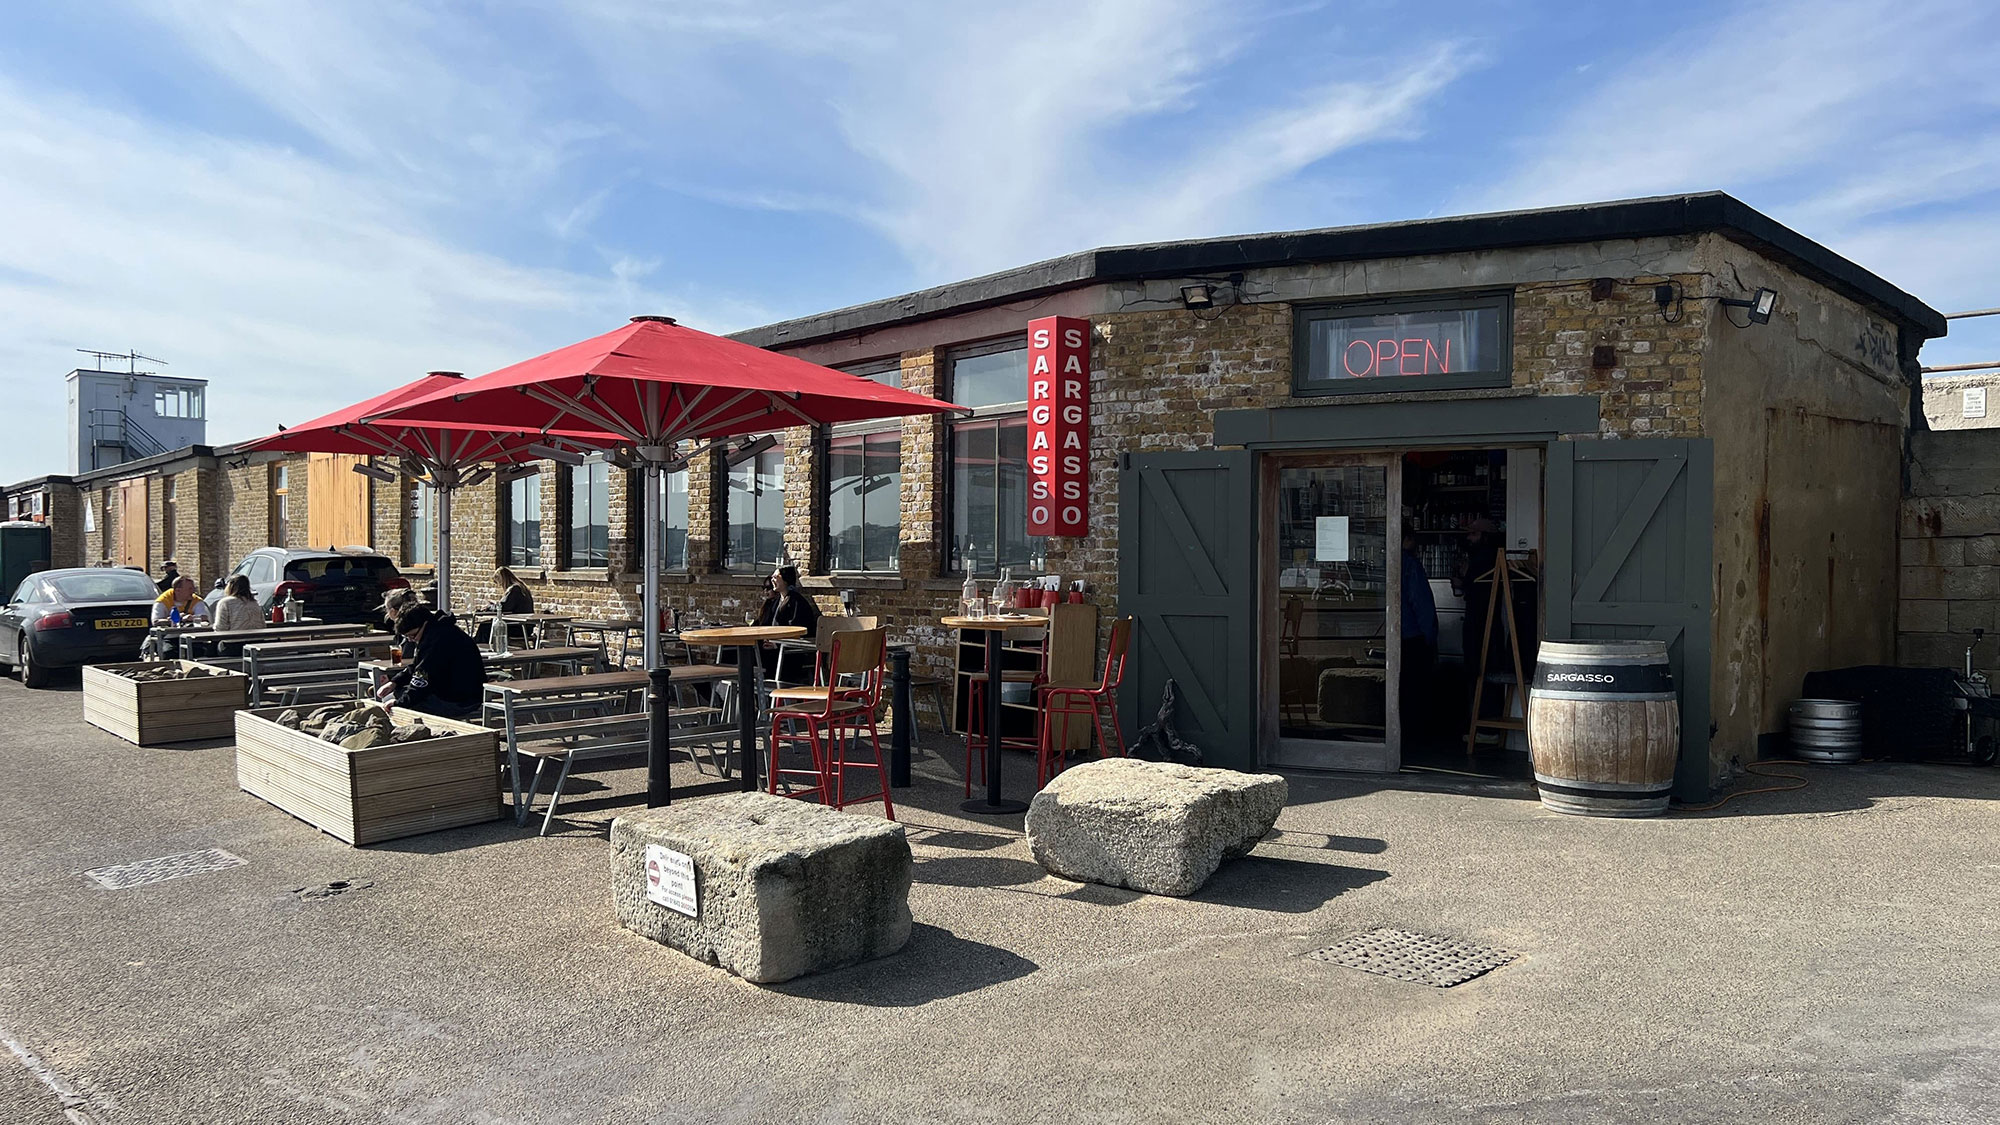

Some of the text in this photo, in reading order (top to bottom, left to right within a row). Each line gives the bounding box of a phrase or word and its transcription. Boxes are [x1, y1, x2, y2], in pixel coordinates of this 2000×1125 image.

[1344, 338, 1450, 377] OPEN
[1032, 329, 1050, 525] SARGASSO
[1062, 329, 1082, 525] SARGASSO
[101, 619, 142, 628] RX51 ZZO
[1547, 673, 1614, 684] SARGASSO
